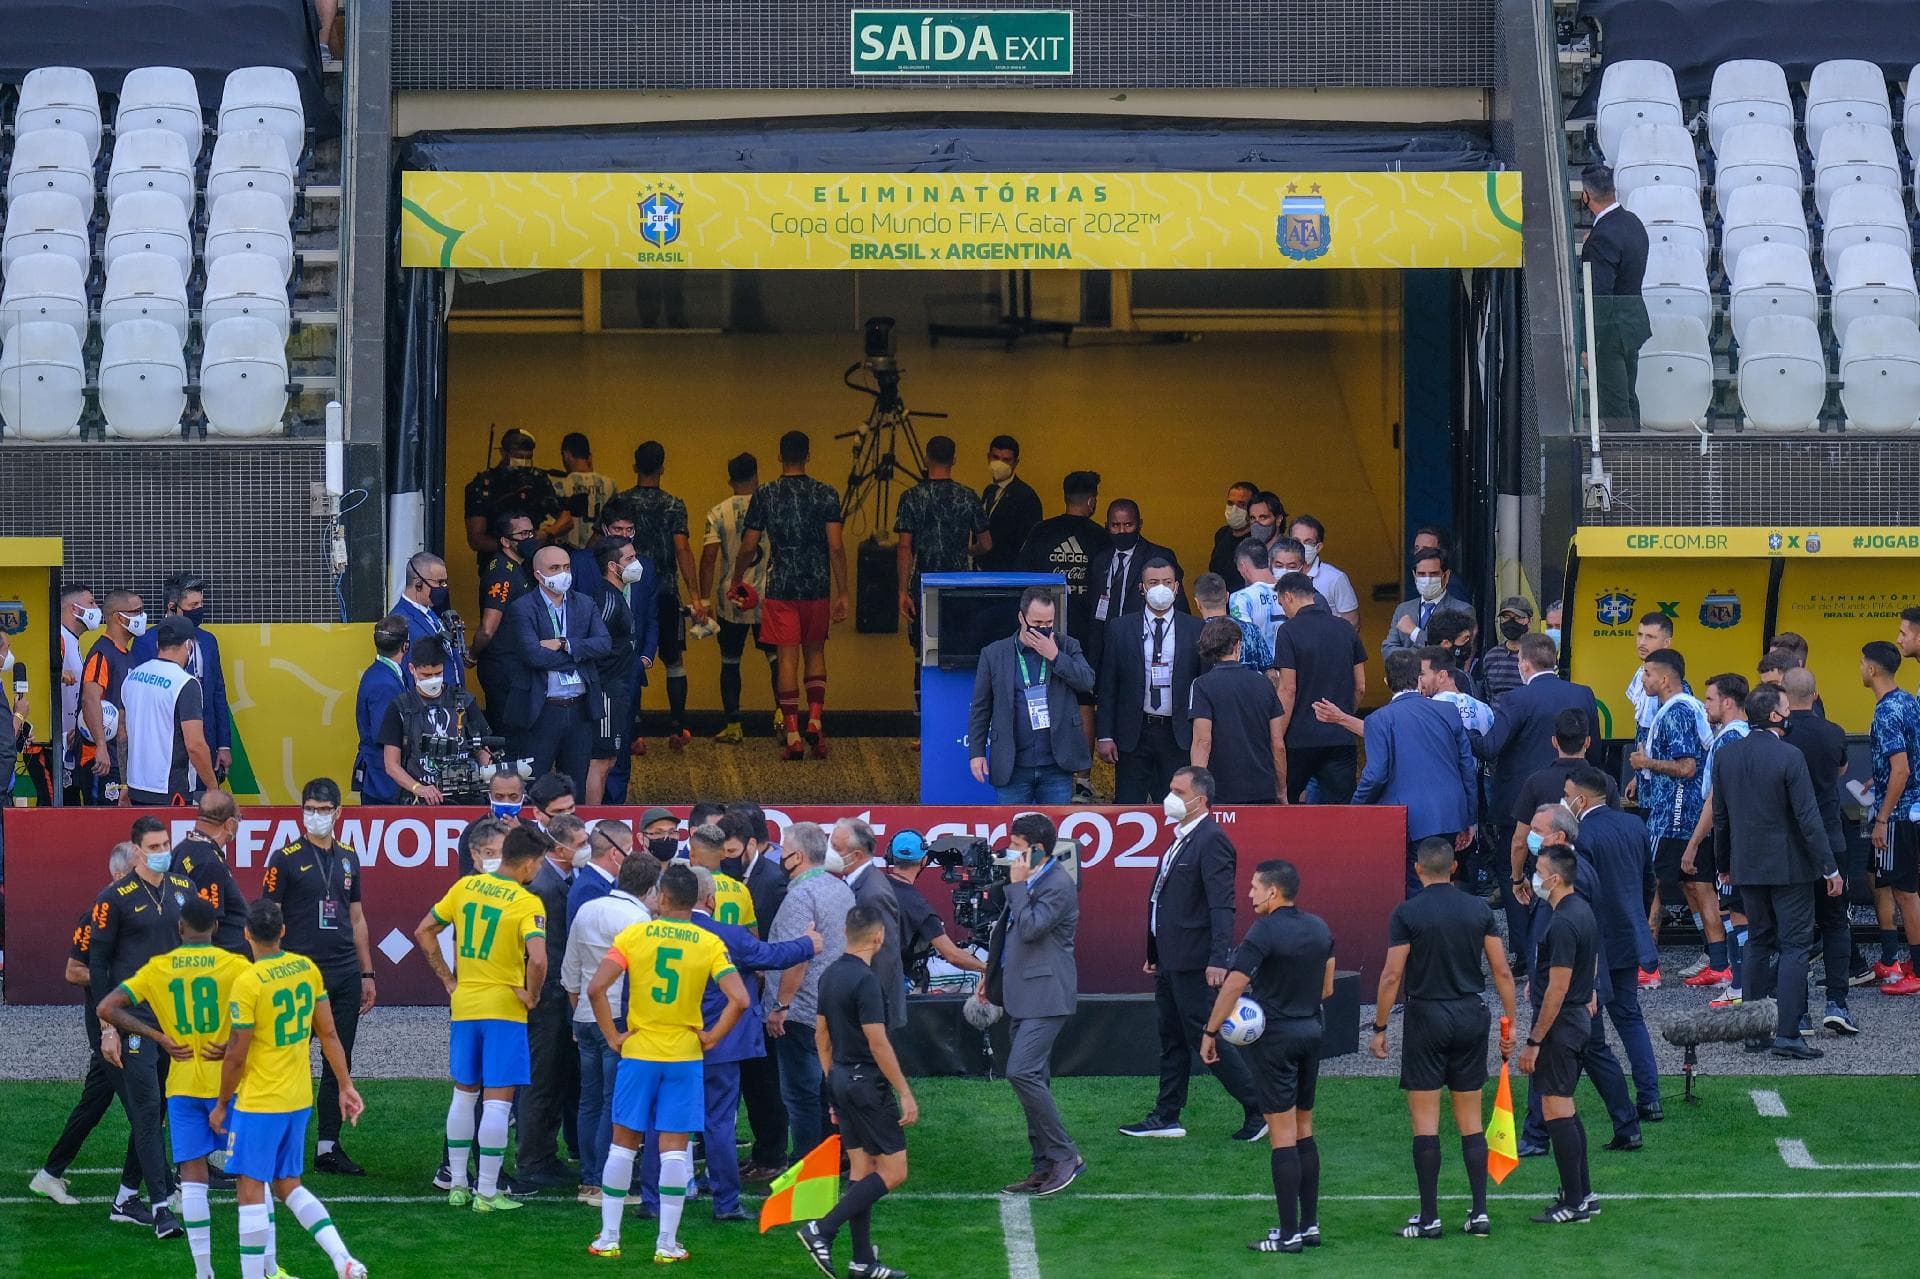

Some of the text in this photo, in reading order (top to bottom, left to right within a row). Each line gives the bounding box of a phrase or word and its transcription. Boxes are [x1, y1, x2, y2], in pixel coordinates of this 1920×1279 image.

[860, 17, 1065, 61] SAÍDA EXIT
[814, 185, 1108, 203] ELIMINATÓRIAS
[770, 212, 828, 236] Copa
[835, 212, 864, 233] do
[872, 212, 952, 234] Mundo
[959, 213, 1008, 233] FIFA
[1015, 213, 1077, 233] Catar
[638, 252, 684, 262] BRASIL
[850, 243, 926, 259] BRASIL
[945, 243, 1072, 259] ARGENTINA
[1627, 534, 1728, 549] CBF.COM.BR
[1049, 552, 1088, 563] adidas
[1593, 629, 1634, 637] BRASIL
[98, 902, 110, 929] vivo
[80, 924, 92, 952] vivo
[460, 902, 503, 960] 17
[646, 925, 700, 943] CASEMIRO
[172, 955, 216, 969] GERSON
[651, 946, 683, 1005] 5
[168, 976, 220, 1035] 18
[272, 981, 313, 1047] 22
